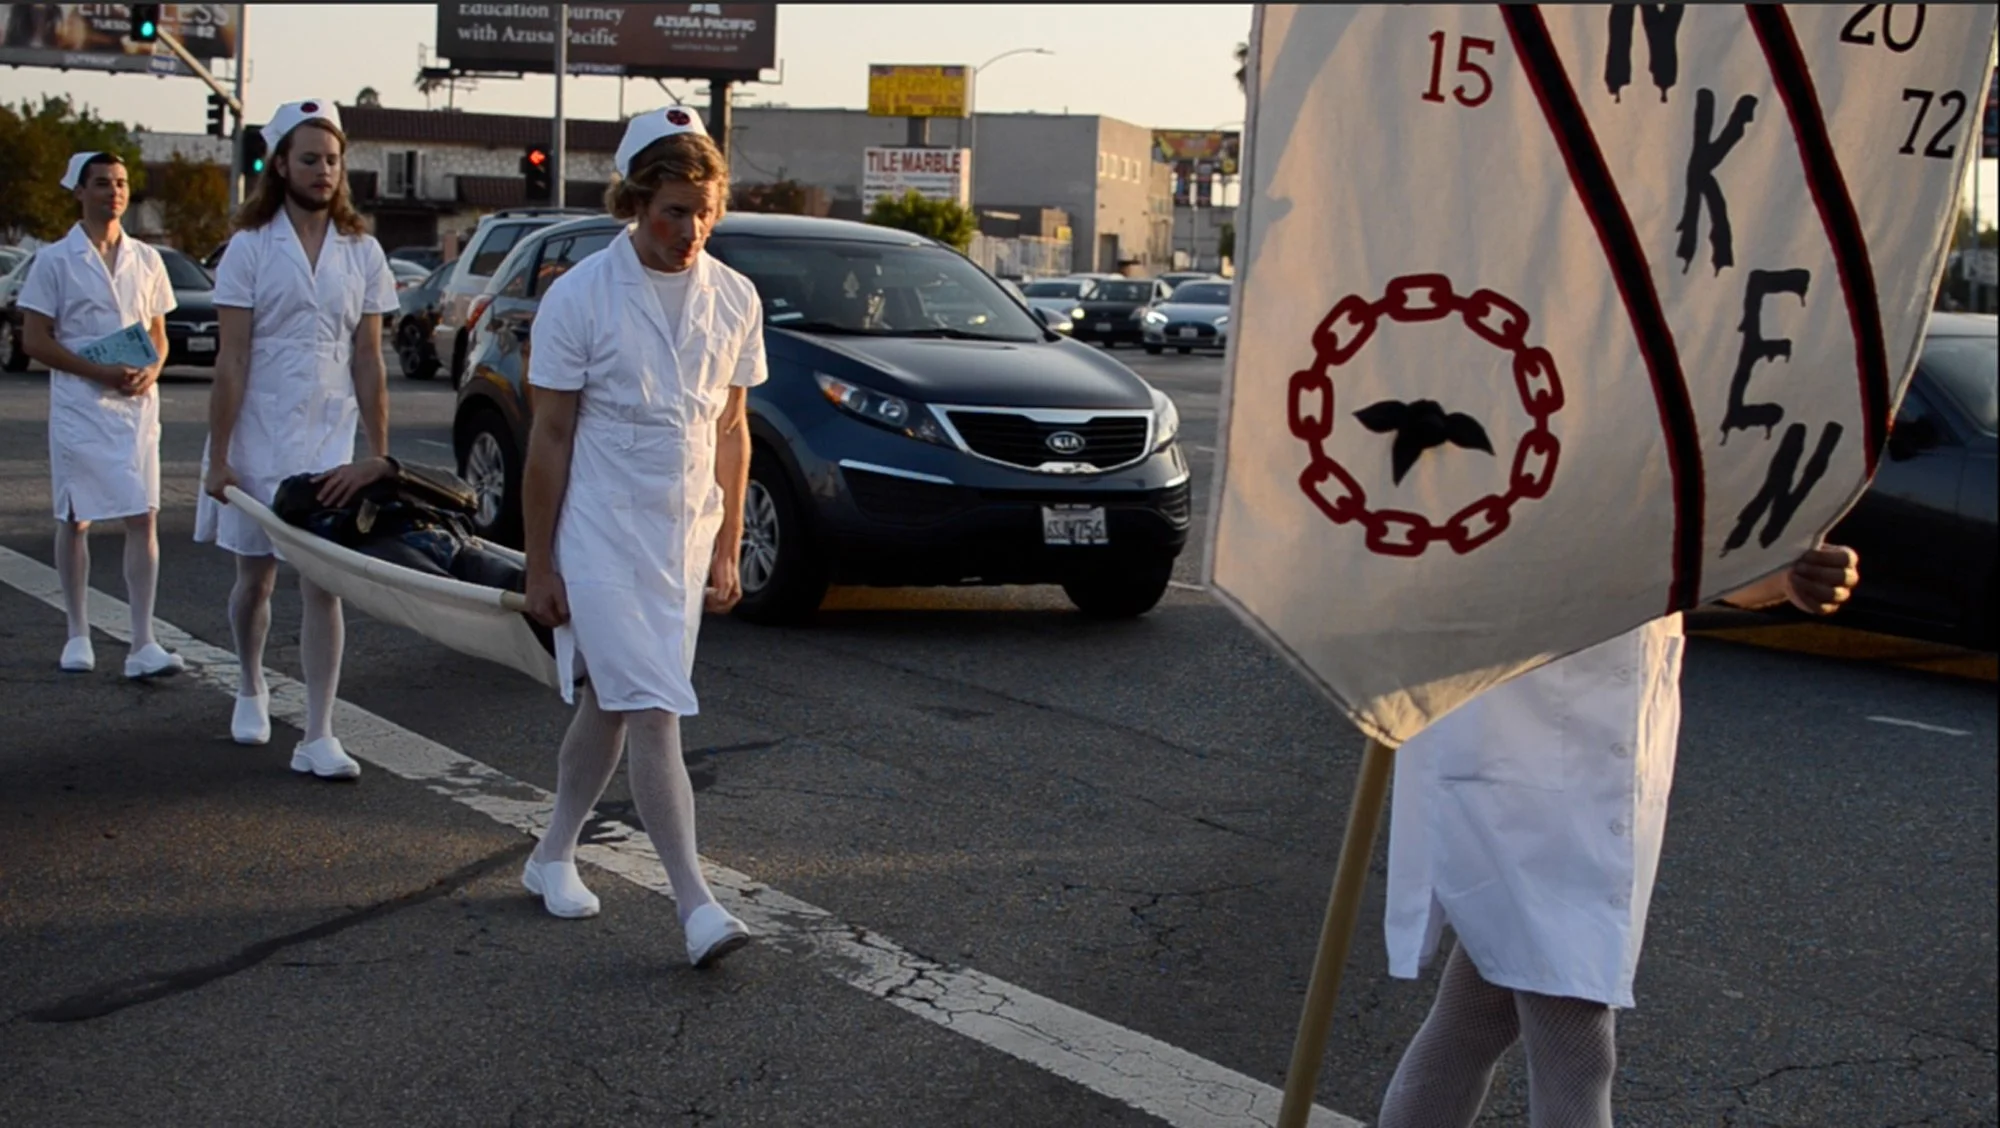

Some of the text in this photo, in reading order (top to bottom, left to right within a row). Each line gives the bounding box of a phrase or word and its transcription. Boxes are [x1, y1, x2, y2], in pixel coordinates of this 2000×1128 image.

[459, 4, 625, 26] Education ourney
[653, 15, 757, 32] AZUSA PACIFIC
[457, 23, 497, 41] with
[502, 26, 554, 43] Azusa
[1839, 4, 1925, 52] 20
[1421, 30, 1495, 107] 15
[1899, 88, 1967, 160] 72
[1053, 436, 1079, 448] KIA
